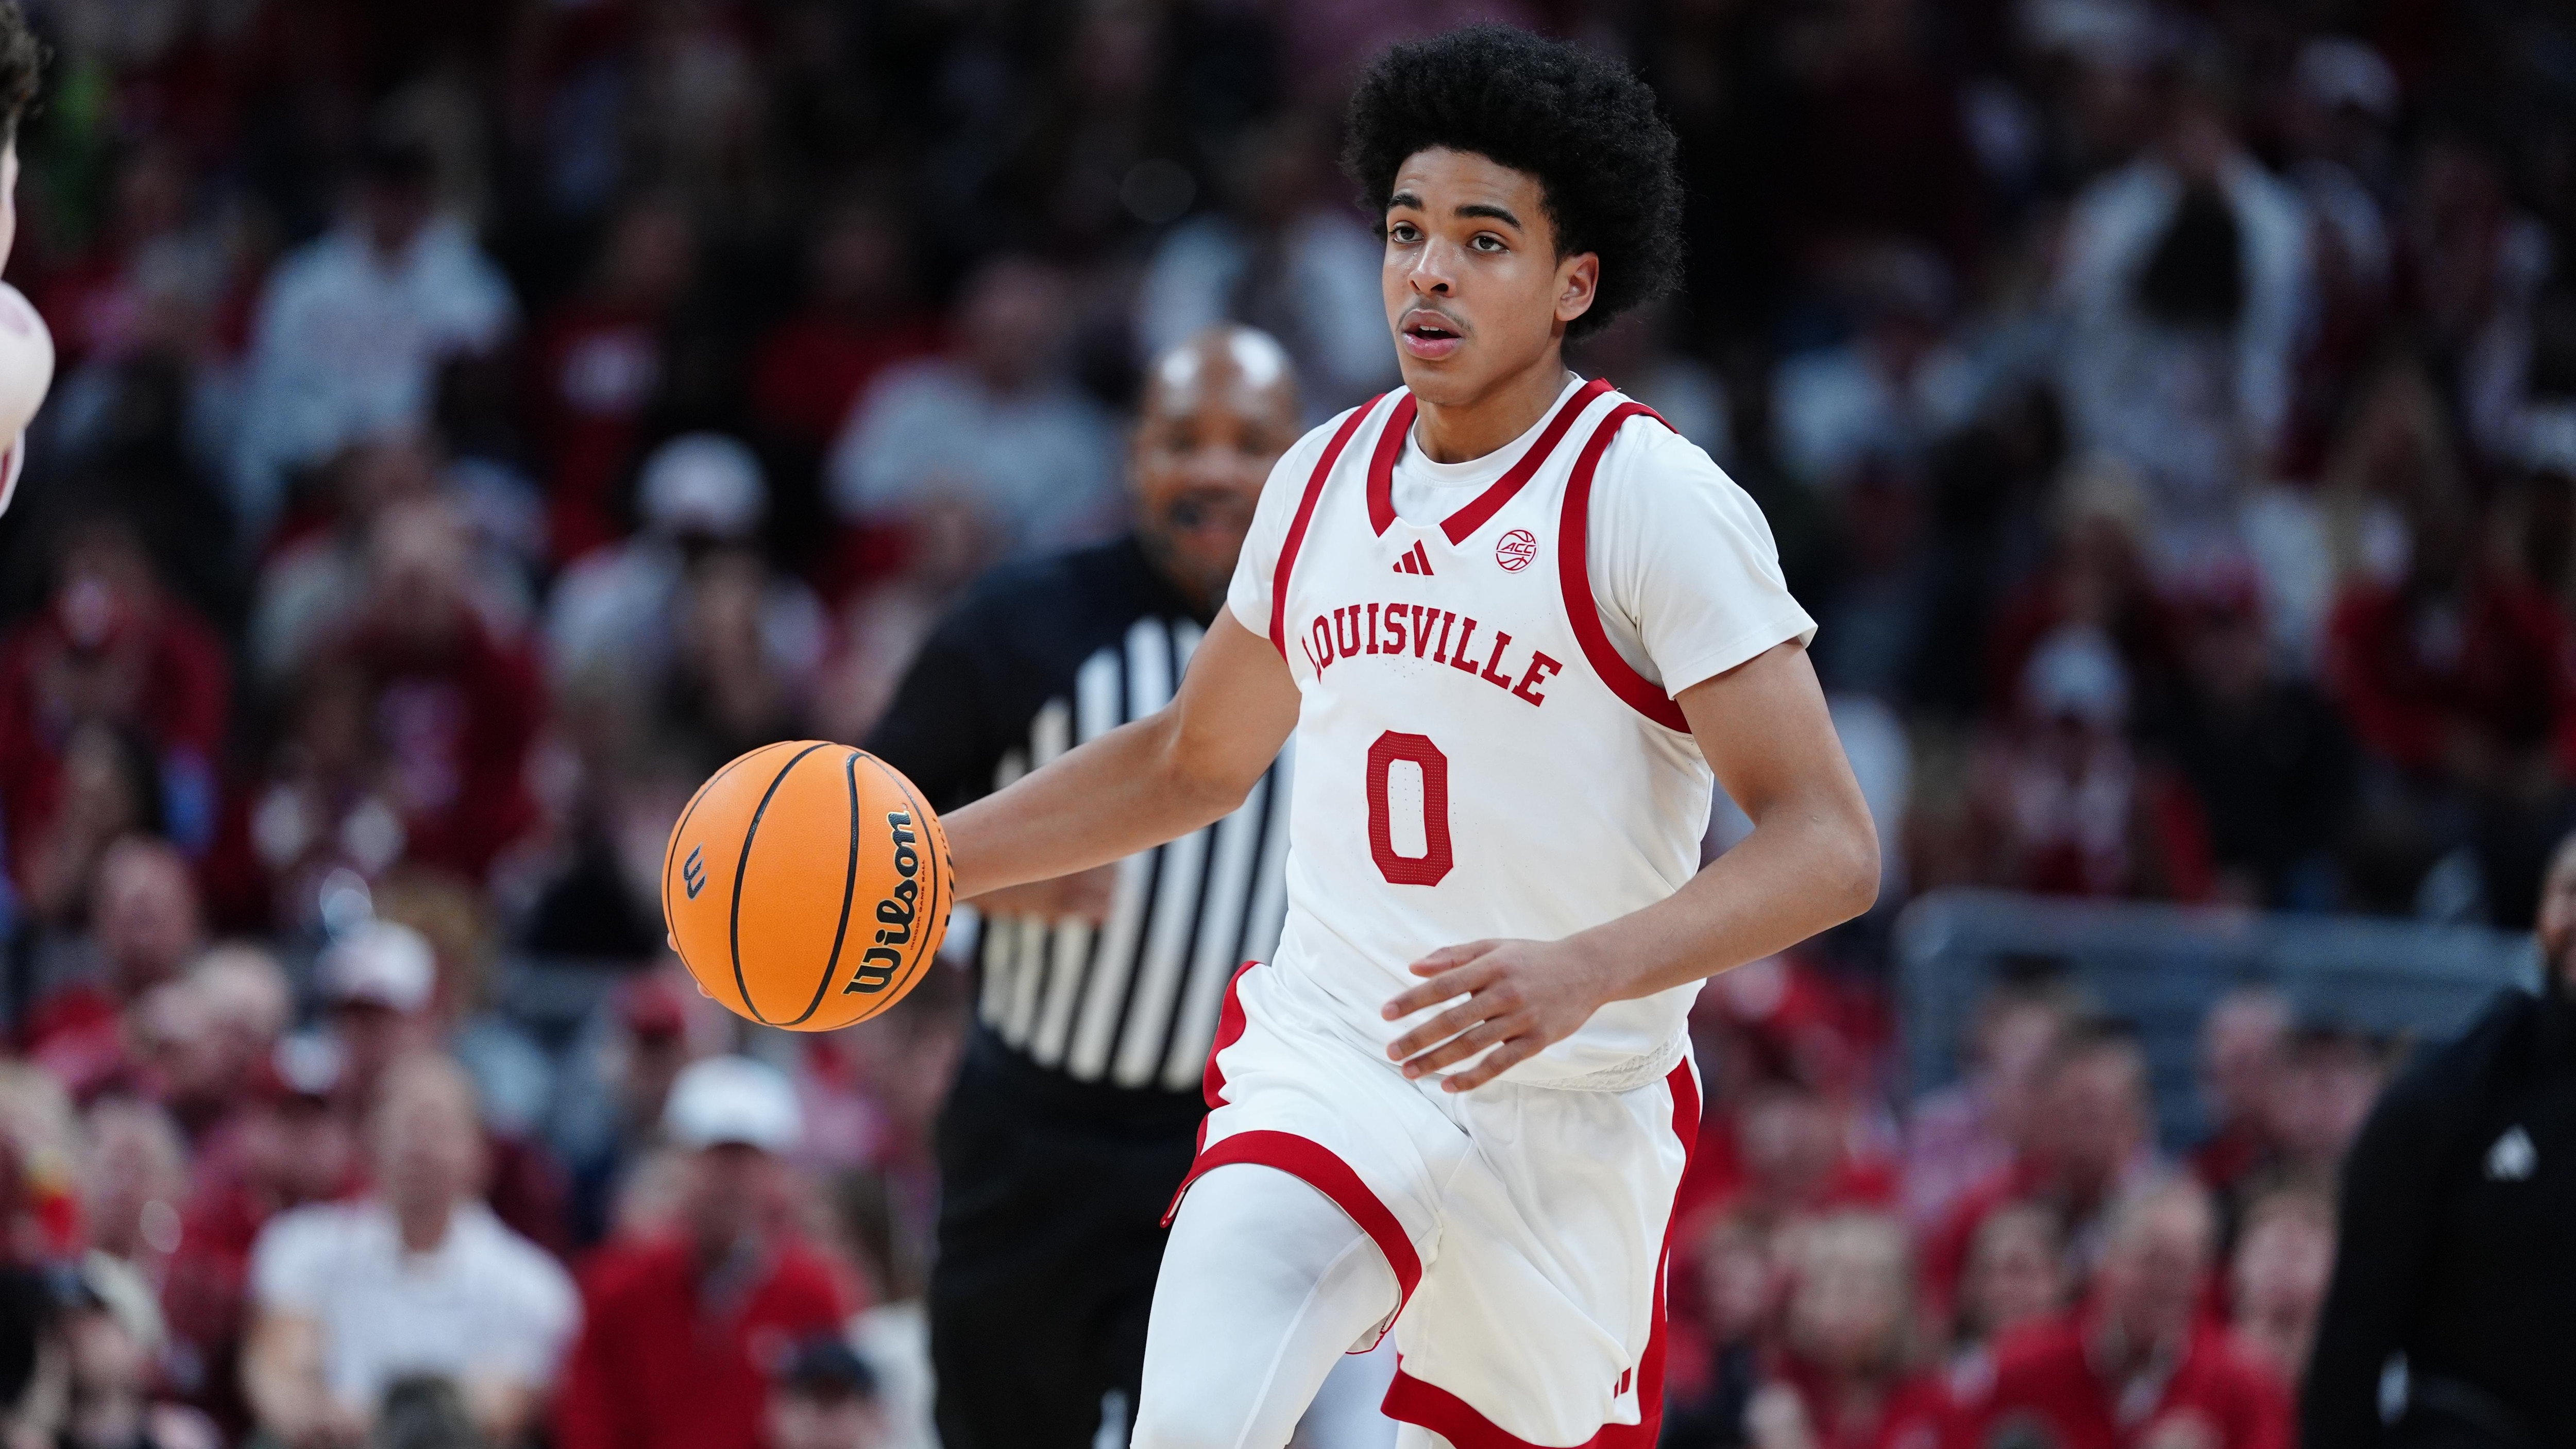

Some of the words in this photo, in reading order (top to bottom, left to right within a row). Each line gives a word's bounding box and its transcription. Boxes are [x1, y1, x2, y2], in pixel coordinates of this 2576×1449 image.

[1500, 542, 1536, 554] ACC
[1301, 603, 1563, 708] LOUISVILLE
[1366, 729, 1454, 888] 0
[841, 809, 920, 996] Wilson
[910, 916, 921, 950] INDOOR
